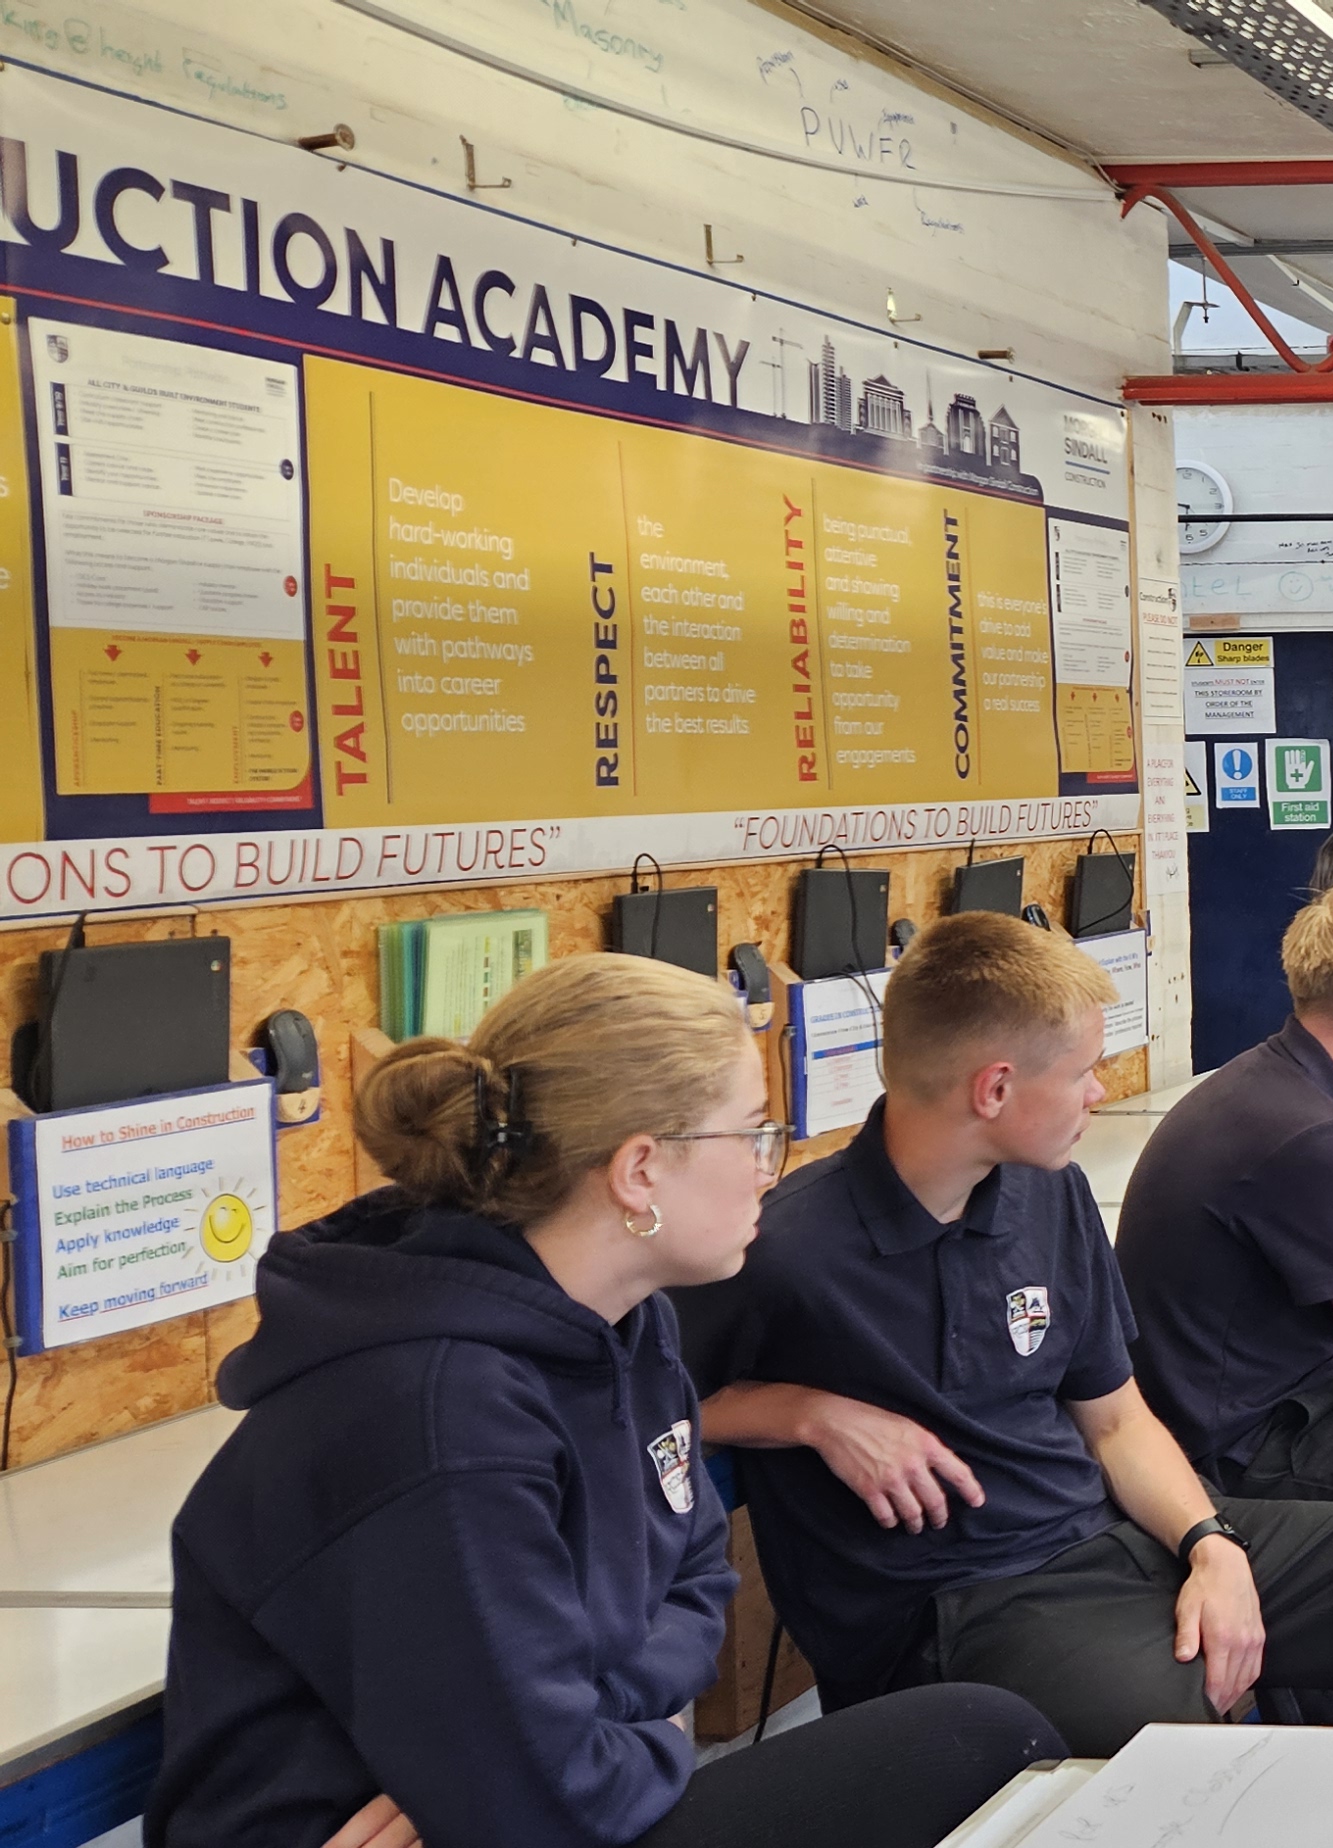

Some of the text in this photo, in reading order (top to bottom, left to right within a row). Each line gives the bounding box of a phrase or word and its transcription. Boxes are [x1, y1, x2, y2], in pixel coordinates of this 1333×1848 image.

[424, 254, 750, 408] ACADEMY
[388, 477, 464, 517] Develop
[389, 516, 515, 560] hard-working
[636, 514, 665, 538] the
[390, 554, 531, 591] individuals and
[391, 596, 519, 625] provide them
[641, 583, 745, 611] each other and
[643, 615, 742, 641] the interaction
[783, 493, 819, 782] RELIABILITY
[944, 508, 971, 781] COMMITMENT
[393, 630, 535, 667] with pathways
[643, 645, 725, 671] between all
[1217, 654, 1270, 663] Sharp blades
[1223, 642, 1263, 654] Danger
[324, 564, 371, 797] TALENT
[397, 667, 503, 695] into career
[589, 552, 620, 787] RESPECT
[644, 683, 757, 706] partners to drive
[400, 708, 526, 738] opportunities
[645, 712, 750, 735] the best results
[1205, 711, 1254, 719] MANAGEMENT
[924, 806, 950, 839] TO
[956, 804, 1012, 837] BUILD
[1281, 802, 1319, 812] First aid
[1285, 812, 1316, 822] station
[147, 843, 216, 895] TO
[233, 836, 365, 889] BUILD
[61, 1105, 255, 1151] How to Shine in Construction
[52, 1158, 214, 1200] Use technical language
[54, 1187, 194, 1227] Explain the Process
[55, 1216, 180, 1255] Apply knowledge
[57, 1241, 187, 1280] Aim for perfection
[59, 1271, 208, 1320] Keep moving forward
